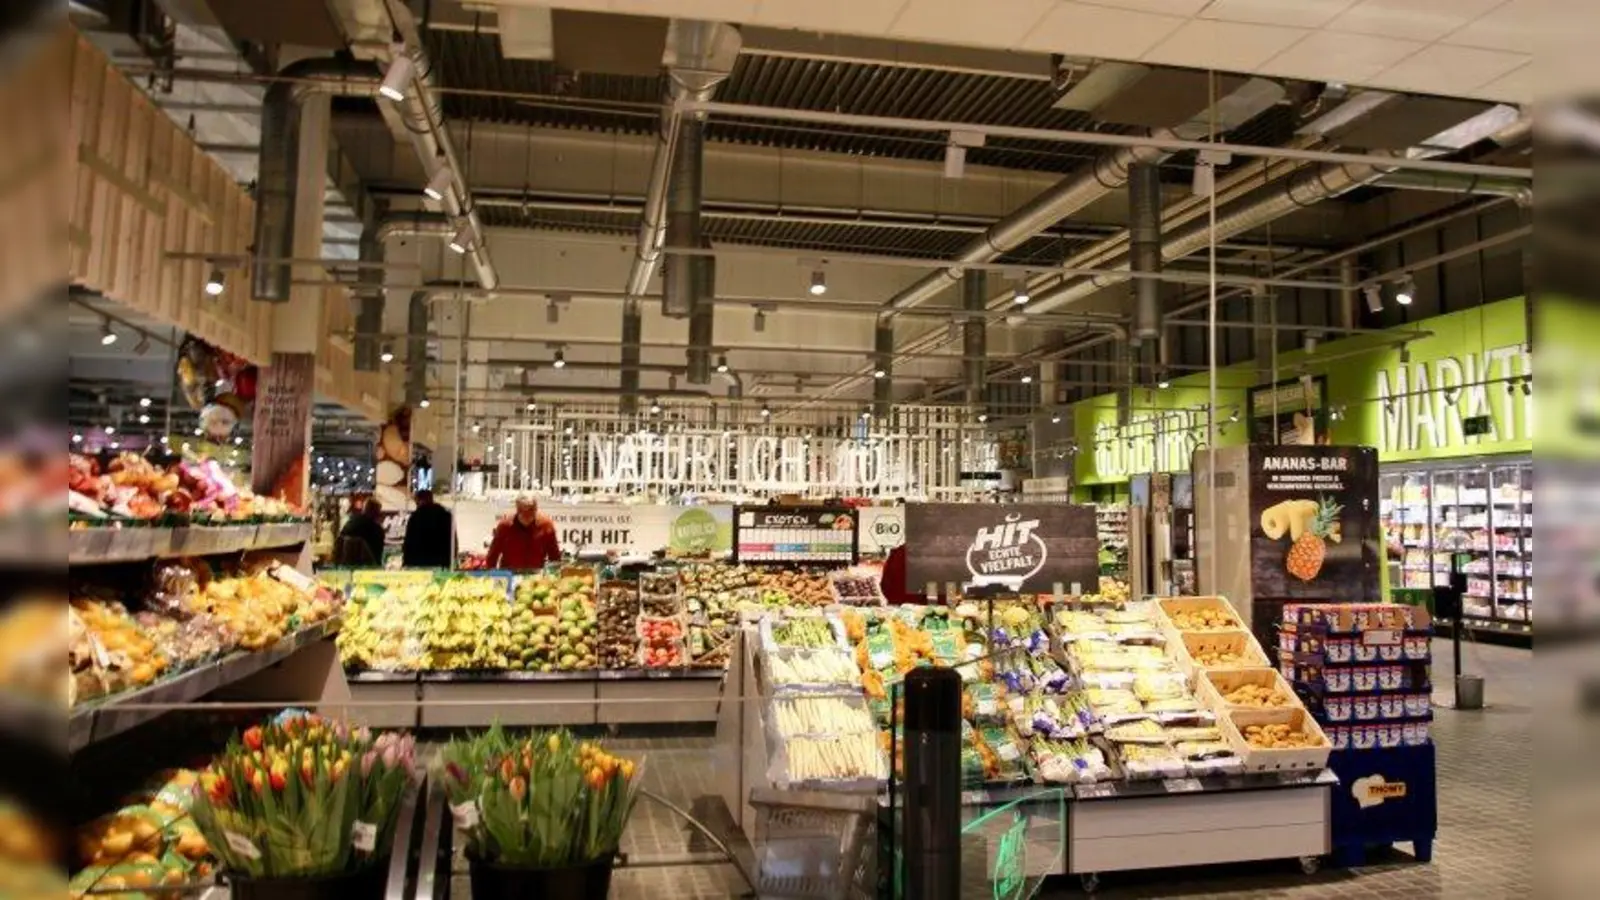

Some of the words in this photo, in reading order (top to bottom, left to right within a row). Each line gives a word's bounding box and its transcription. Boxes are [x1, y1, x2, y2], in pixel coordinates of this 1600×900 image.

[587, 431, 807, 488] NATÜRLICH
[1262, 457, 1347, 470] ANANAS-BAR
[764, 515, 809, 524] EXOTEN
[601, 528, 634, 544] HIT.
[974, 512, 1040, 551] HIT
[988, 547, 1021, 560] ECHTE
[980, 555, 1037, 573] VIELFALT.
[1369, 784, 1403, 794] THOMY
